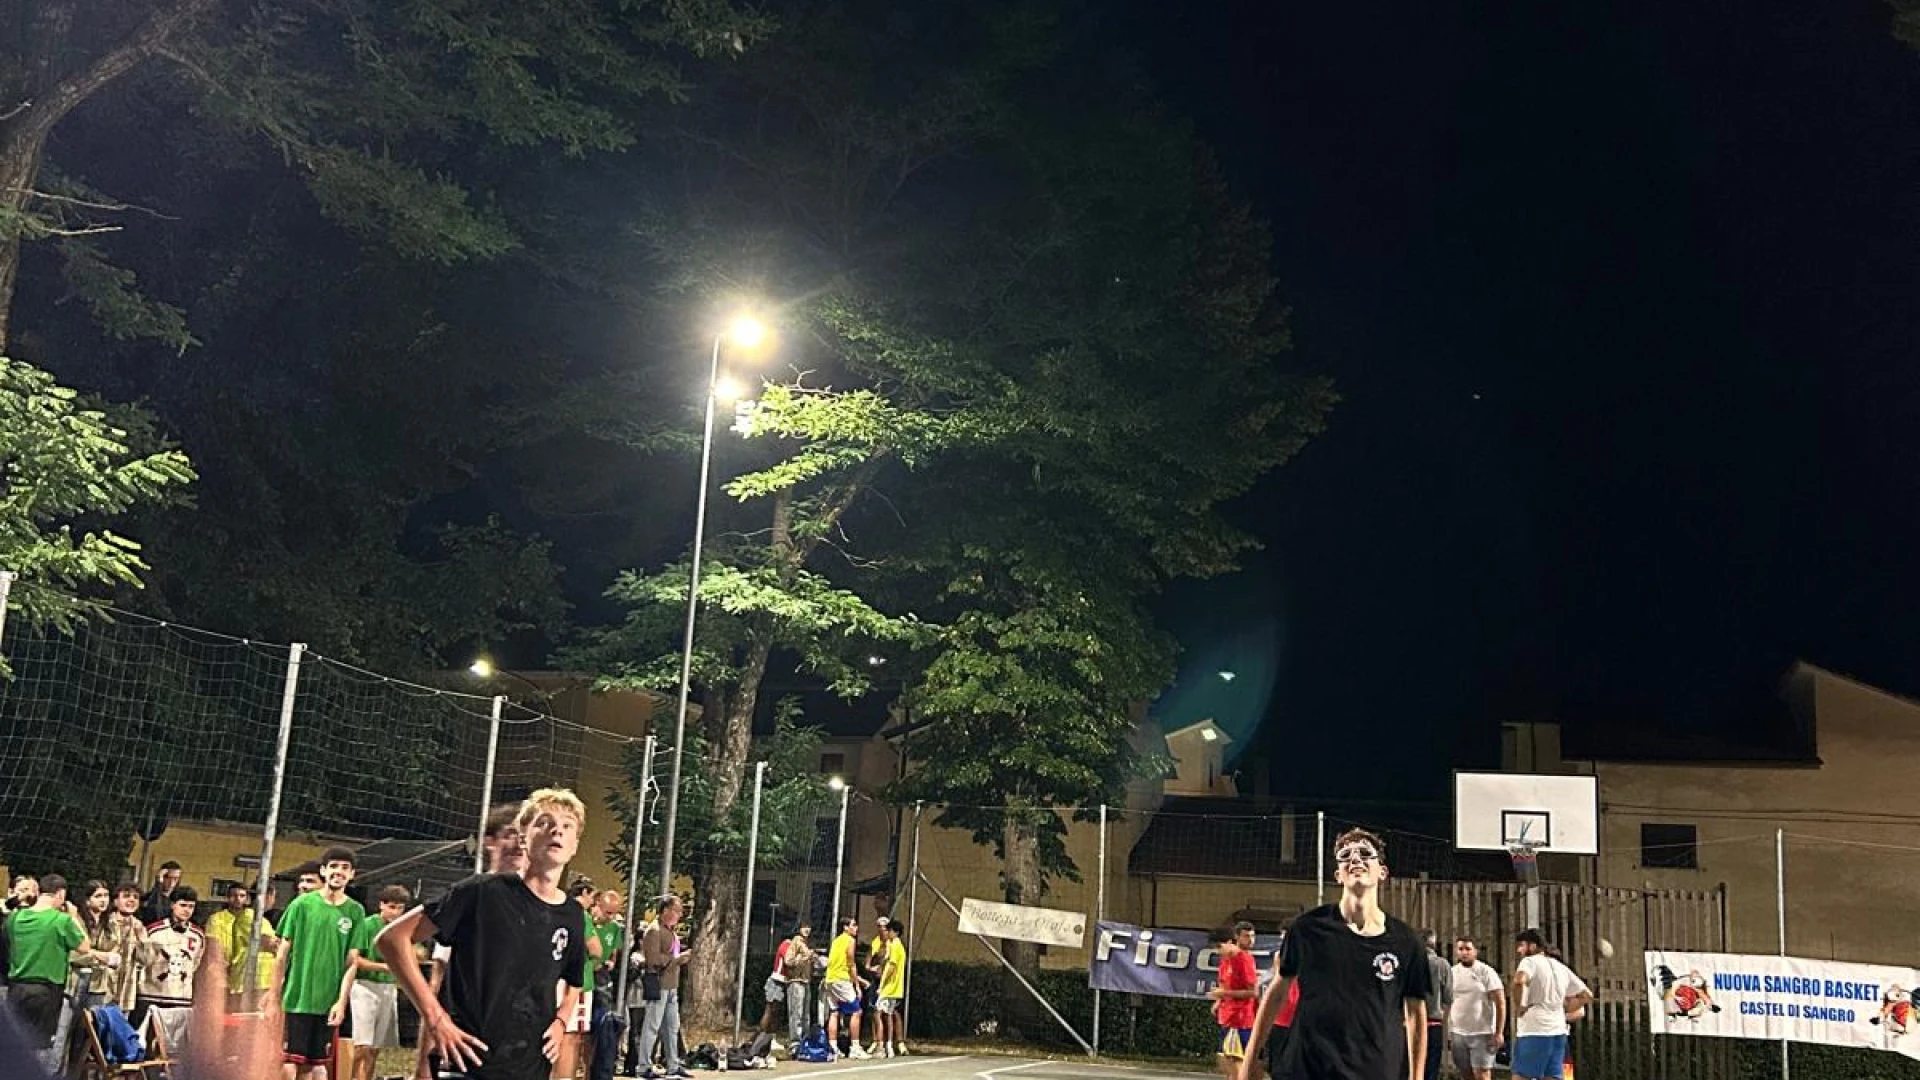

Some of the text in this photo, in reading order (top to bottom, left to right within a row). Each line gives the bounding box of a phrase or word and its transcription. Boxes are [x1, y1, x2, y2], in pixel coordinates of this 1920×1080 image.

[1713, 972, 1880, 1002] NUOVA SANGRO BASKET
[1740, 1001, 1855, 1023] CASTEL DI SANGRO
